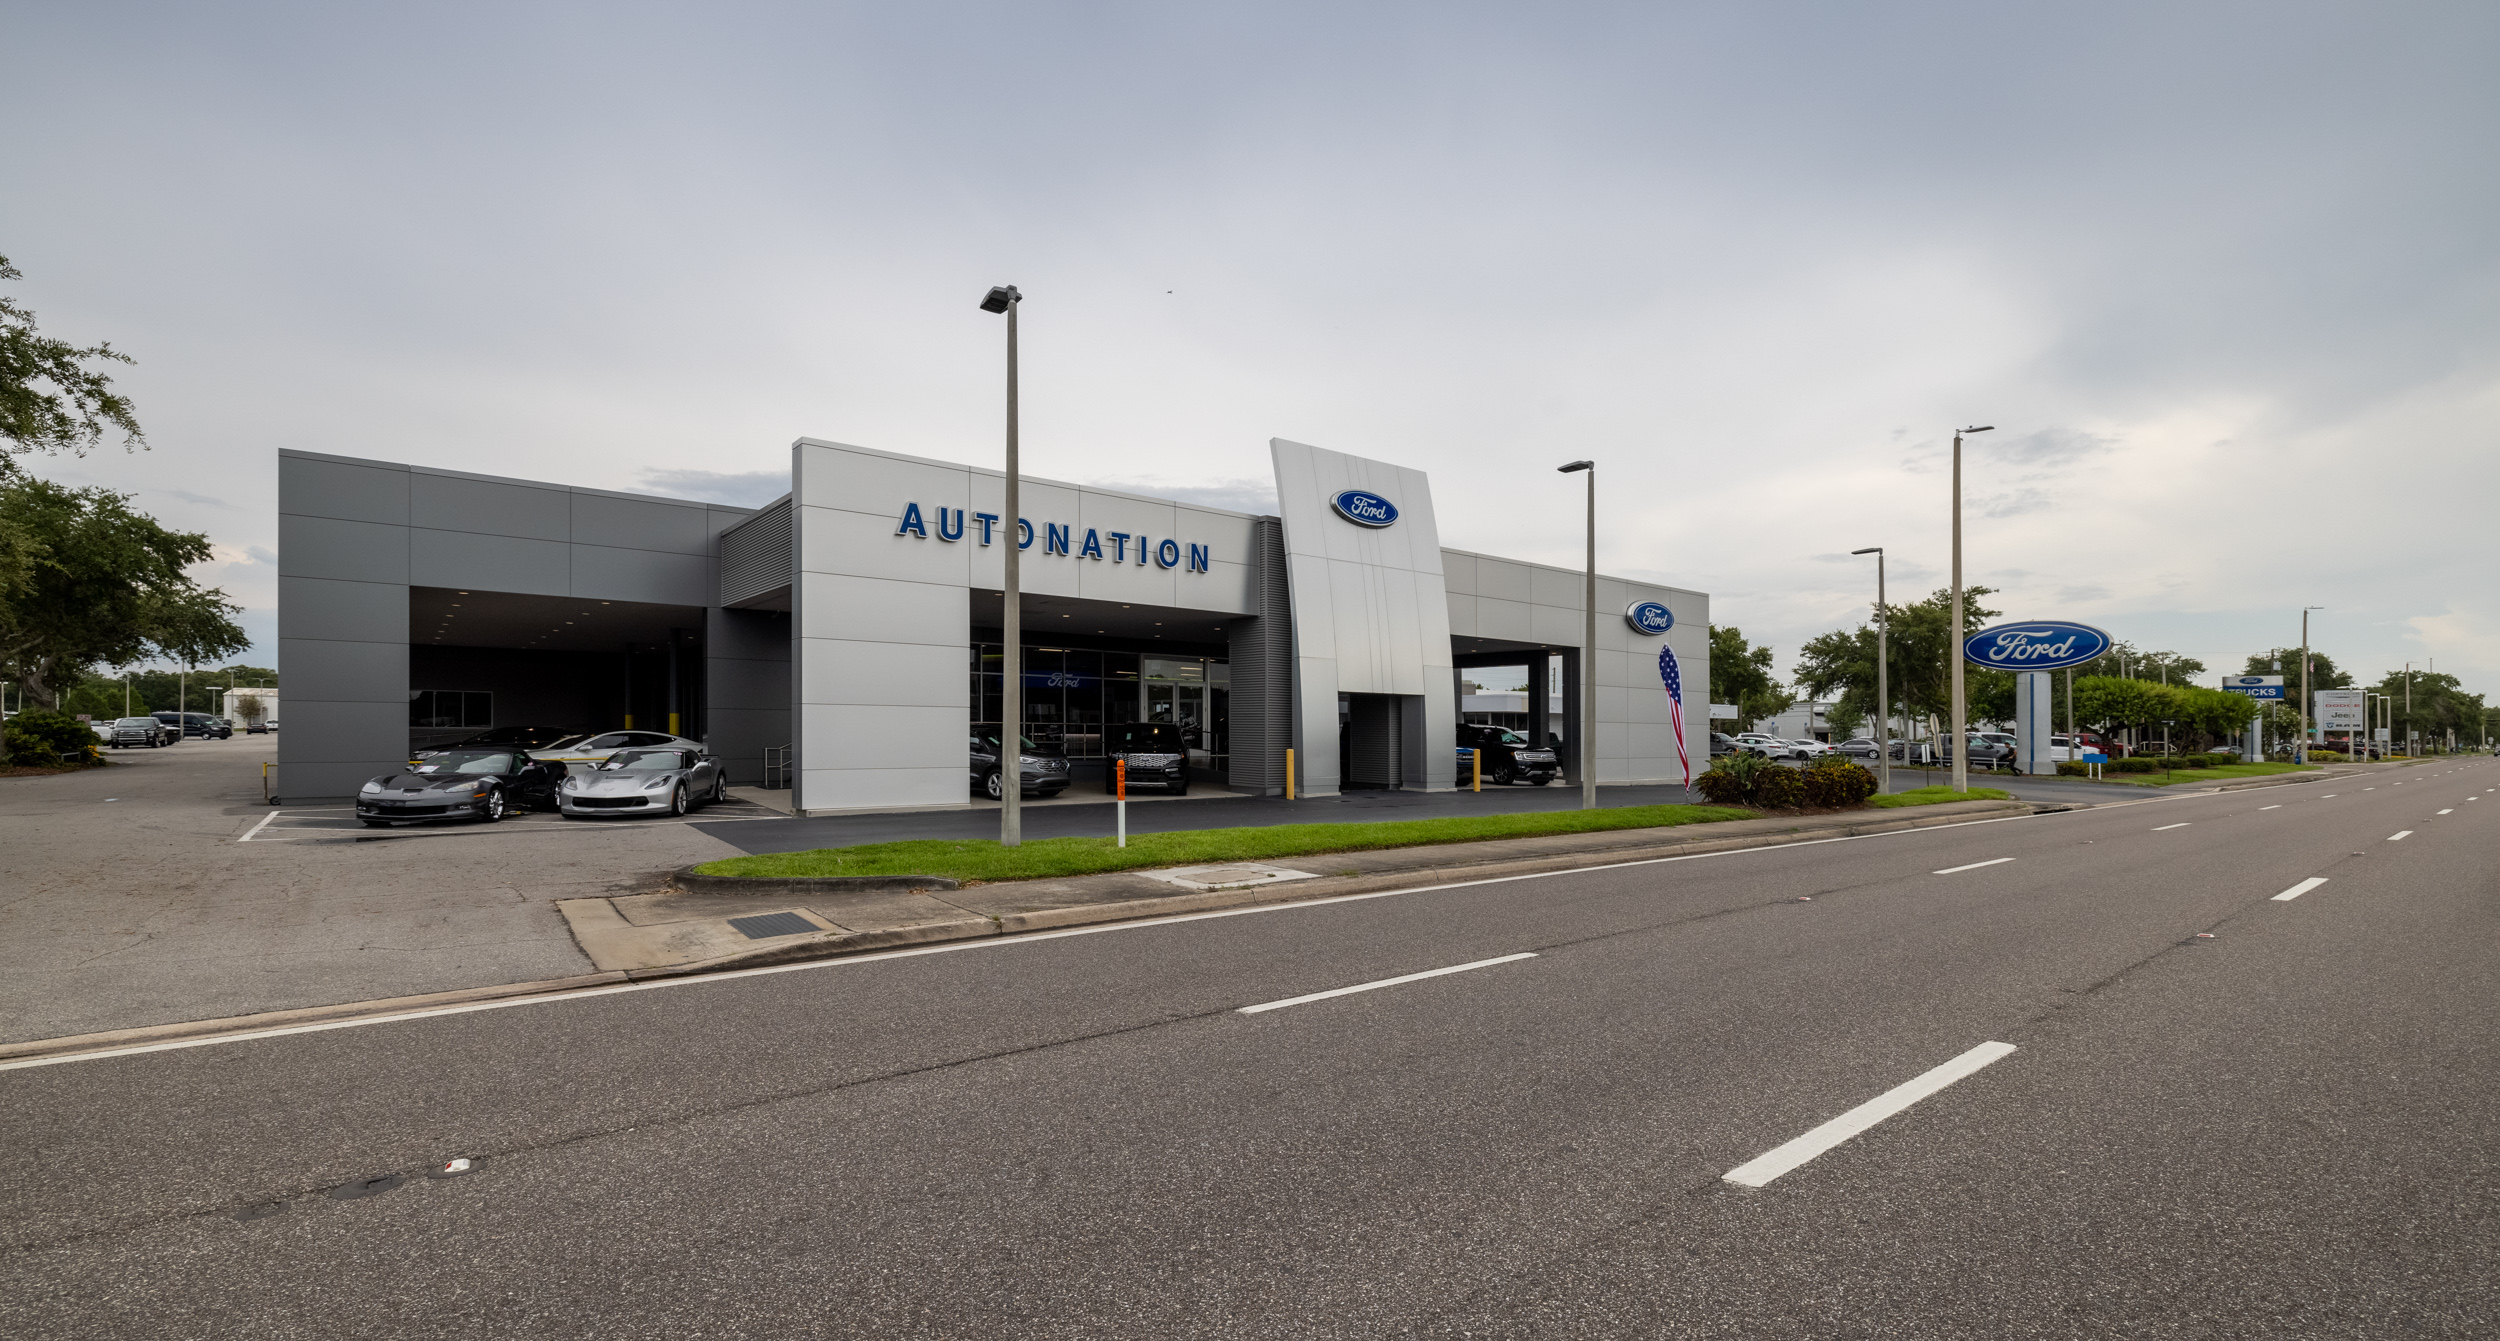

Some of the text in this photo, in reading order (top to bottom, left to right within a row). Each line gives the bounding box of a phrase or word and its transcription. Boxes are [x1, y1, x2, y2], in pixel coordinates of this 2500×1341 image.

[1351, 495, 1387, 520] Ford
[895, 500, 1210, 574] AUTONATION
[1642, 607, 1668, 628] Ford
[1988, 630, 2077, 661] Ford
